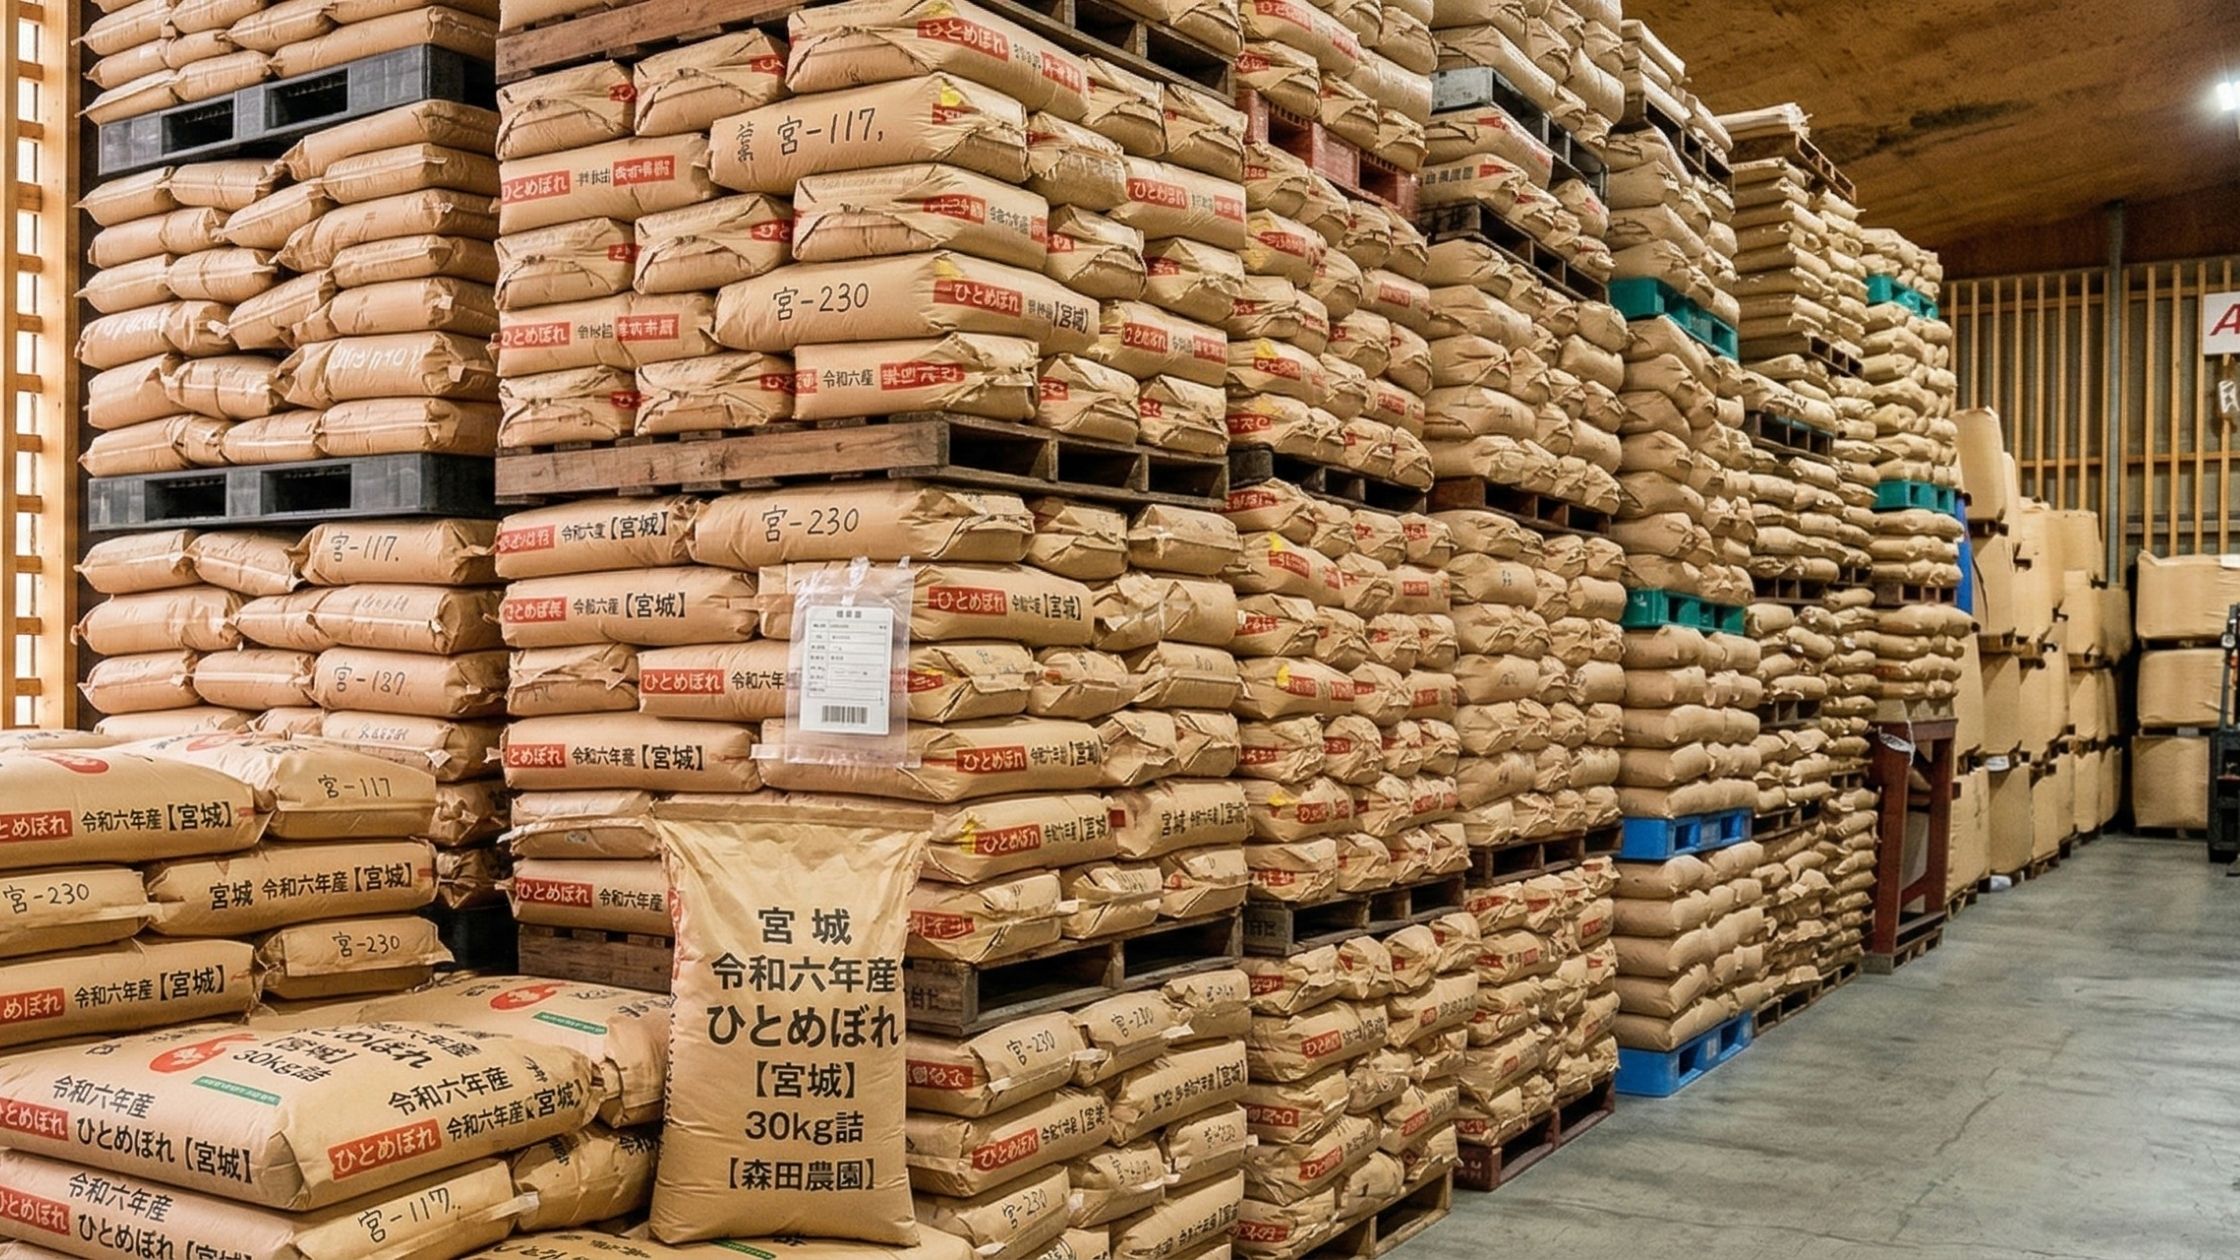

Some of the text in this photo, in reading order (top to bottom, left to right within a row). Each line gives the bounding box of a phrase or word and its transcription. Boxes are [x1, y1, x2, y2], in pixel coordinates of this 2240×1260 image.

[772, 283, 870, 322] 宮-230
[762, 504, 859, 543] 宮-230
[643, 671, 721, 691] ひとめぼれ
[318, 775, 391, 799] 宮-117
[80, 801, 233, 833] 令和六年産【宮城】
[2, 882, 90, 914] 宮-230
[209, 862, 413, 911] 宮城 令和六年産【宮城】
[599, 888, 664, 912] 令和六年産
[331, 931, 400, 958] 宮-230
[758, 907, 852, 945] 宮城
[711, 953, 898, 993] 令和六年産
[707, 1004, 899, 1048] ひとめぼれ
[51, 1075, 156, 1120] 令和六年産
[387, 1066, 514, 1117] 令和六年産
[756, 1061, 855, 1099] 【宮城】
[0, 1101, 65, 1136] とめぼれ
[745, 1110, 864, 1145] 30kg詰
[333, 1124, 438, 1173] ひとめぼれ
[68, 1171, 173, 1223] 令和六年産
